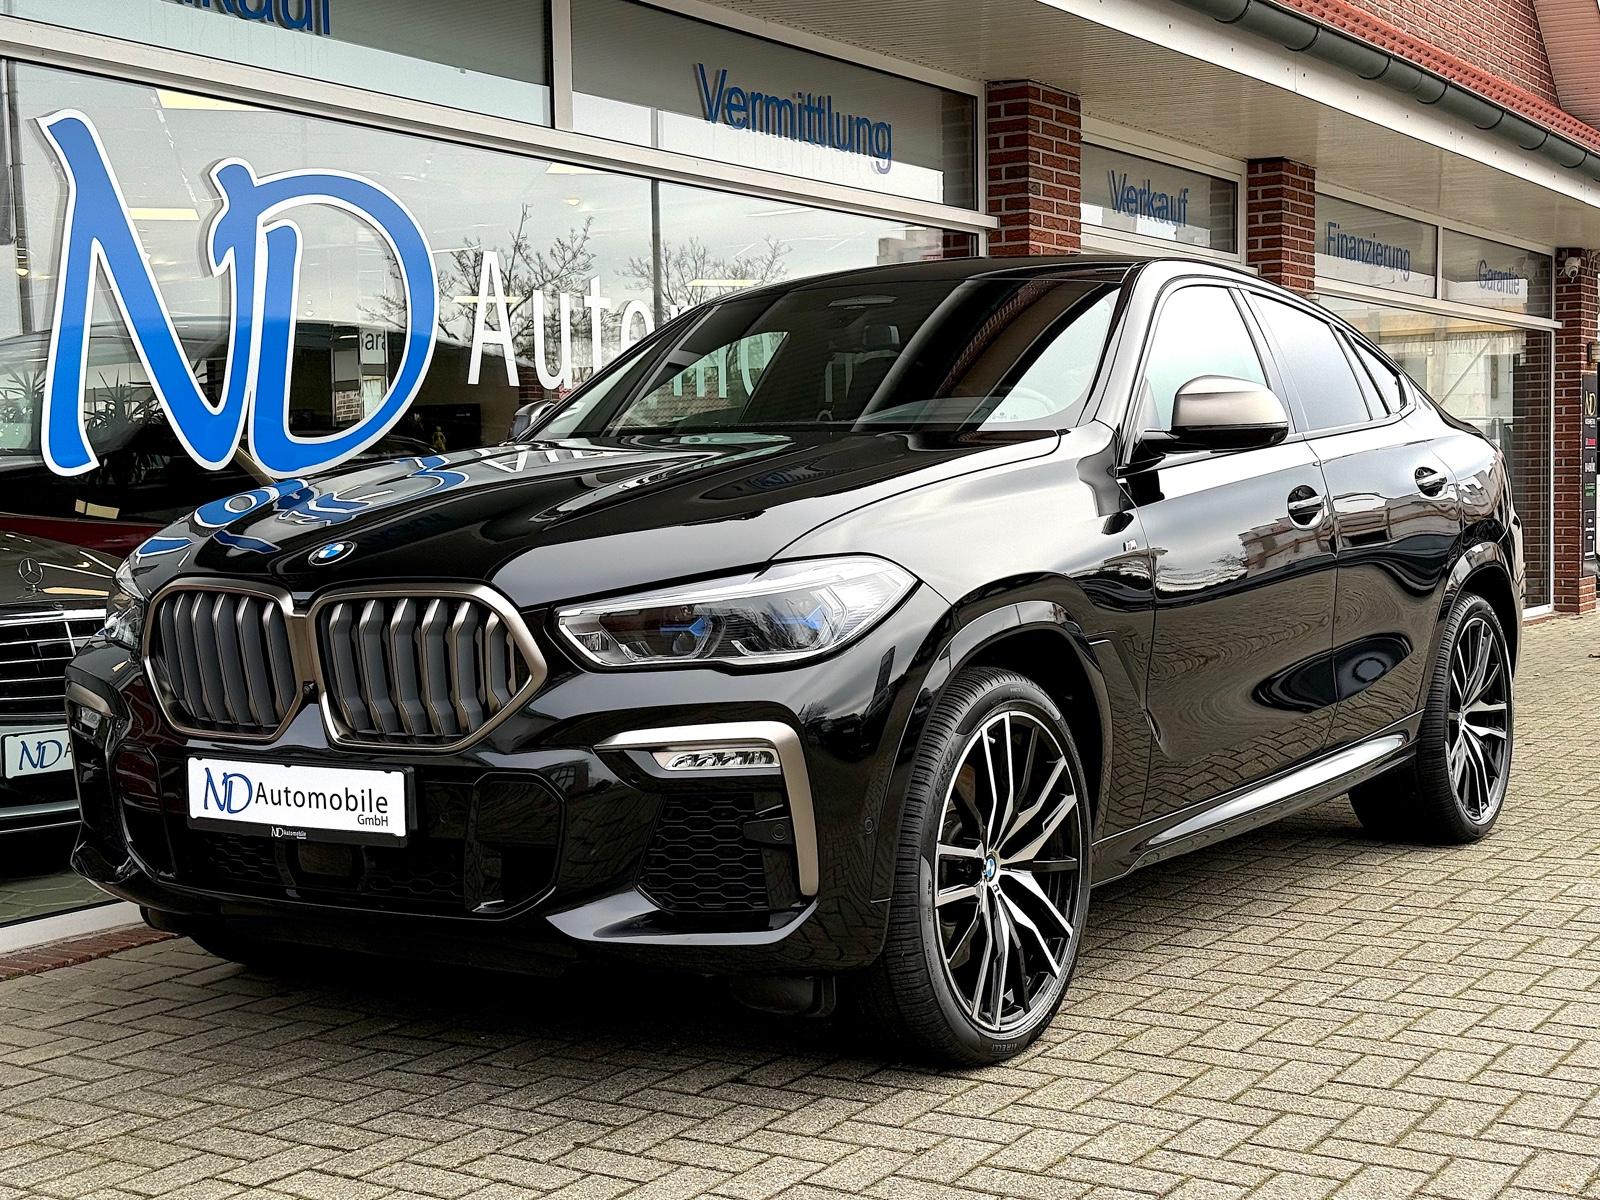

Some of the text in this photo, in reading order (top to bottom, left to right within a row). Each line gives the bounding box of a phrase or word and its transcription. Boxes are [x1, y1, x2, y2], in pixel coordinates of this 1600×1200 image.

[697, 63, 892, 175] Vermittlung
[1109, 170, 1189, 227] Verkauf
[1326, 221, 1411, 282] Finanzierung
[1477, 259, 1520, 295] Garantie
[37, 109, 440, 479] ND
[19, 739, 63, 771] ND
[203, 767, 389, 815] ND Automobile
[356, 814, 389, 827] GmbH
